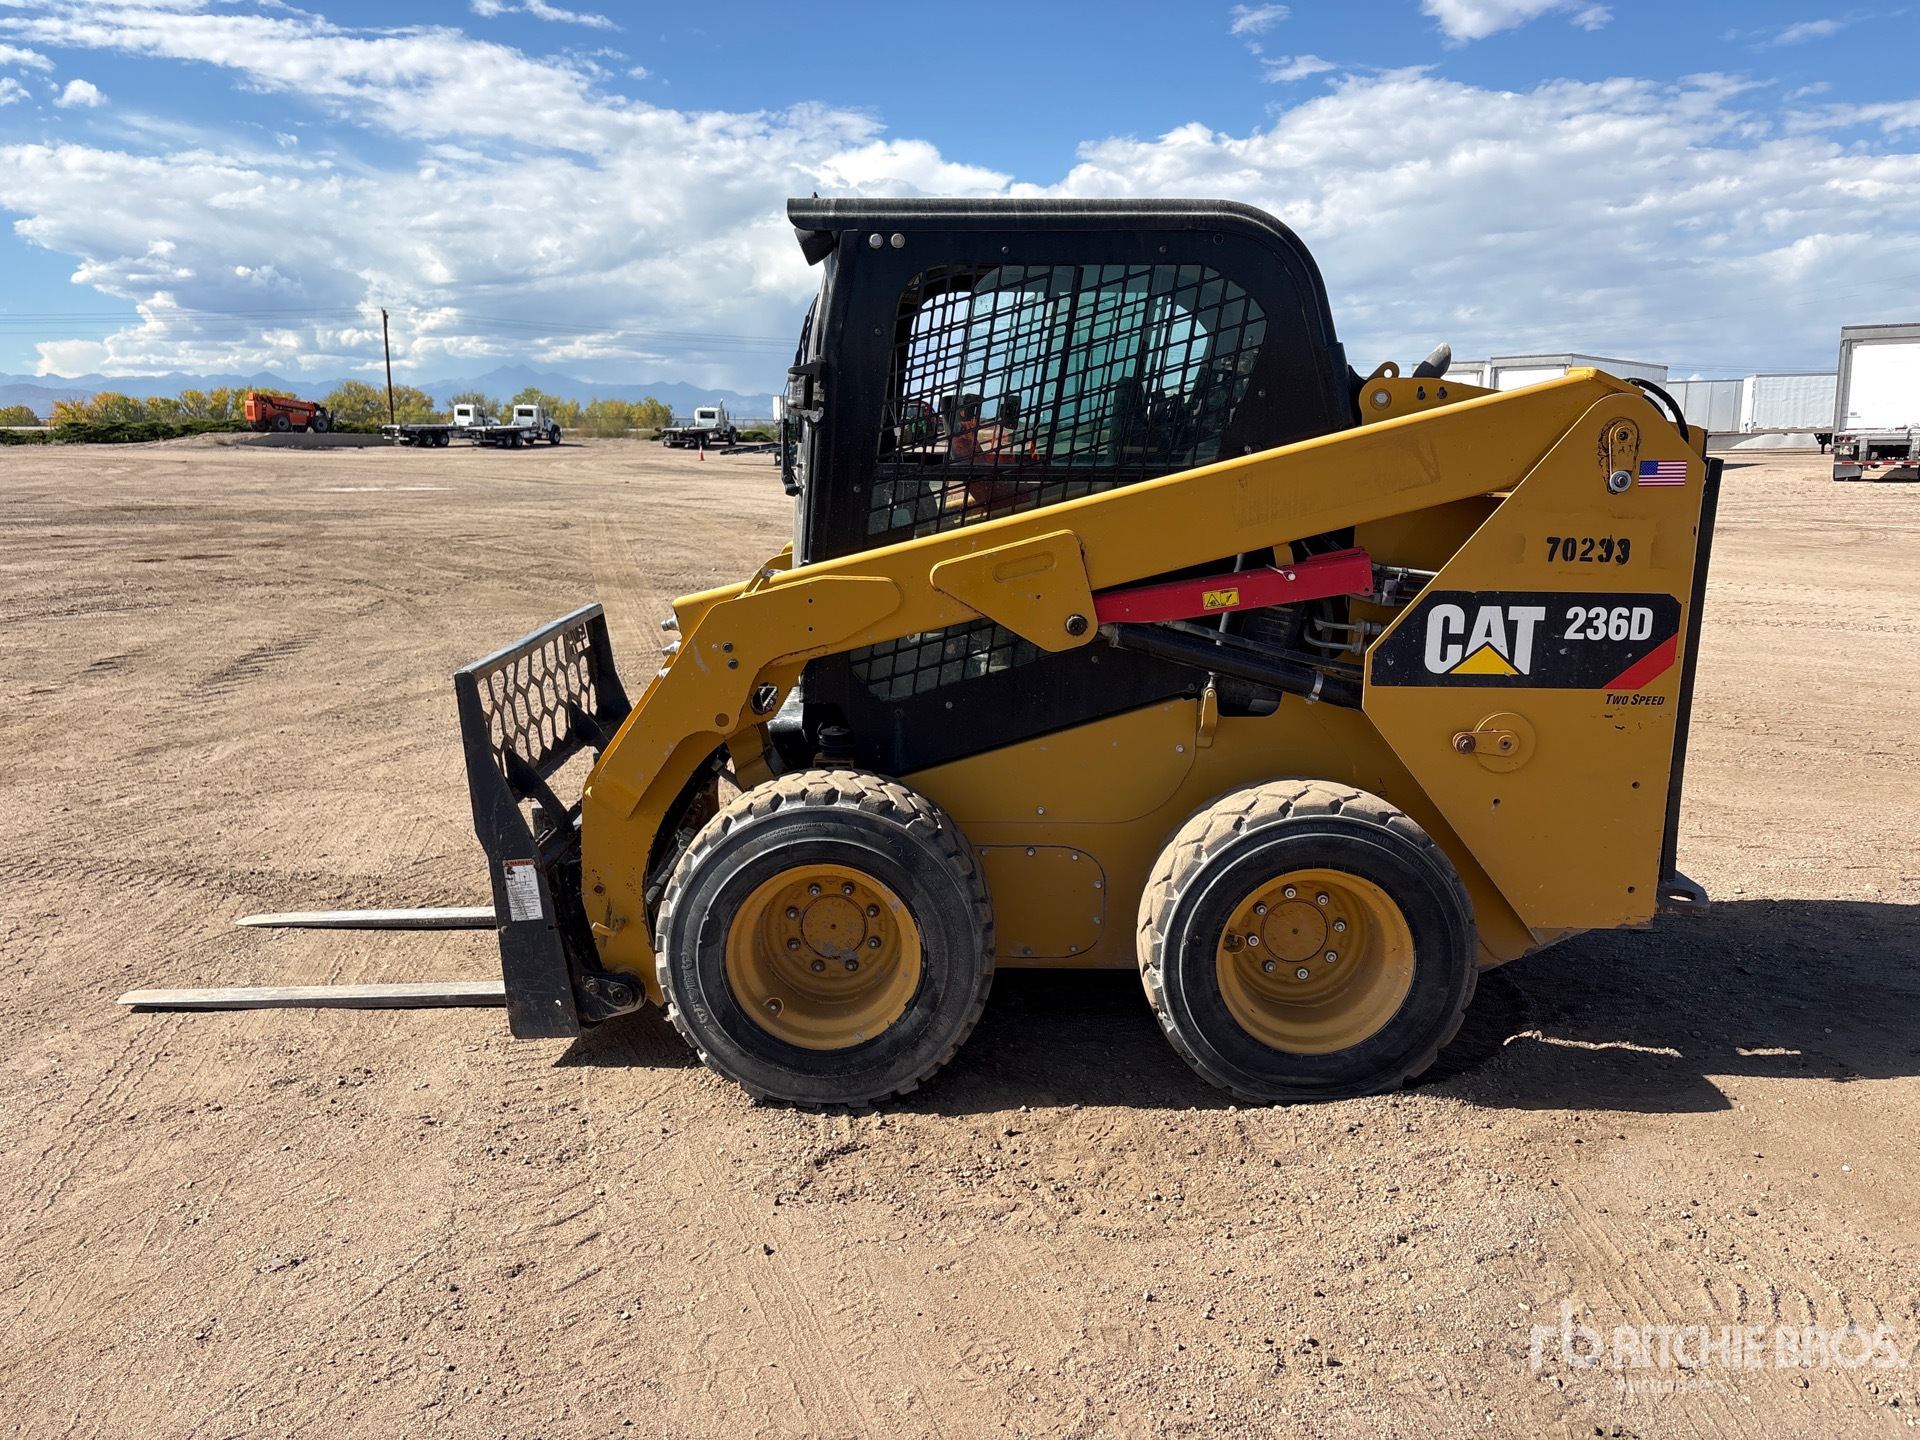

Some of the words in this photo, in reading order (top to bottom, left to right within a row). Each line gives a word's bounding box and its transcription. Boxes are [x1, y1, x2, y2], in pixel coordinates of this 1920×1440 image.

[1424, 603, 1546, 675] CAT
[1563, 606, 1654, 641] 236D
[1605, 693, 1629, 705] TWO
[1630, 693, 1665, 706] SPEED
